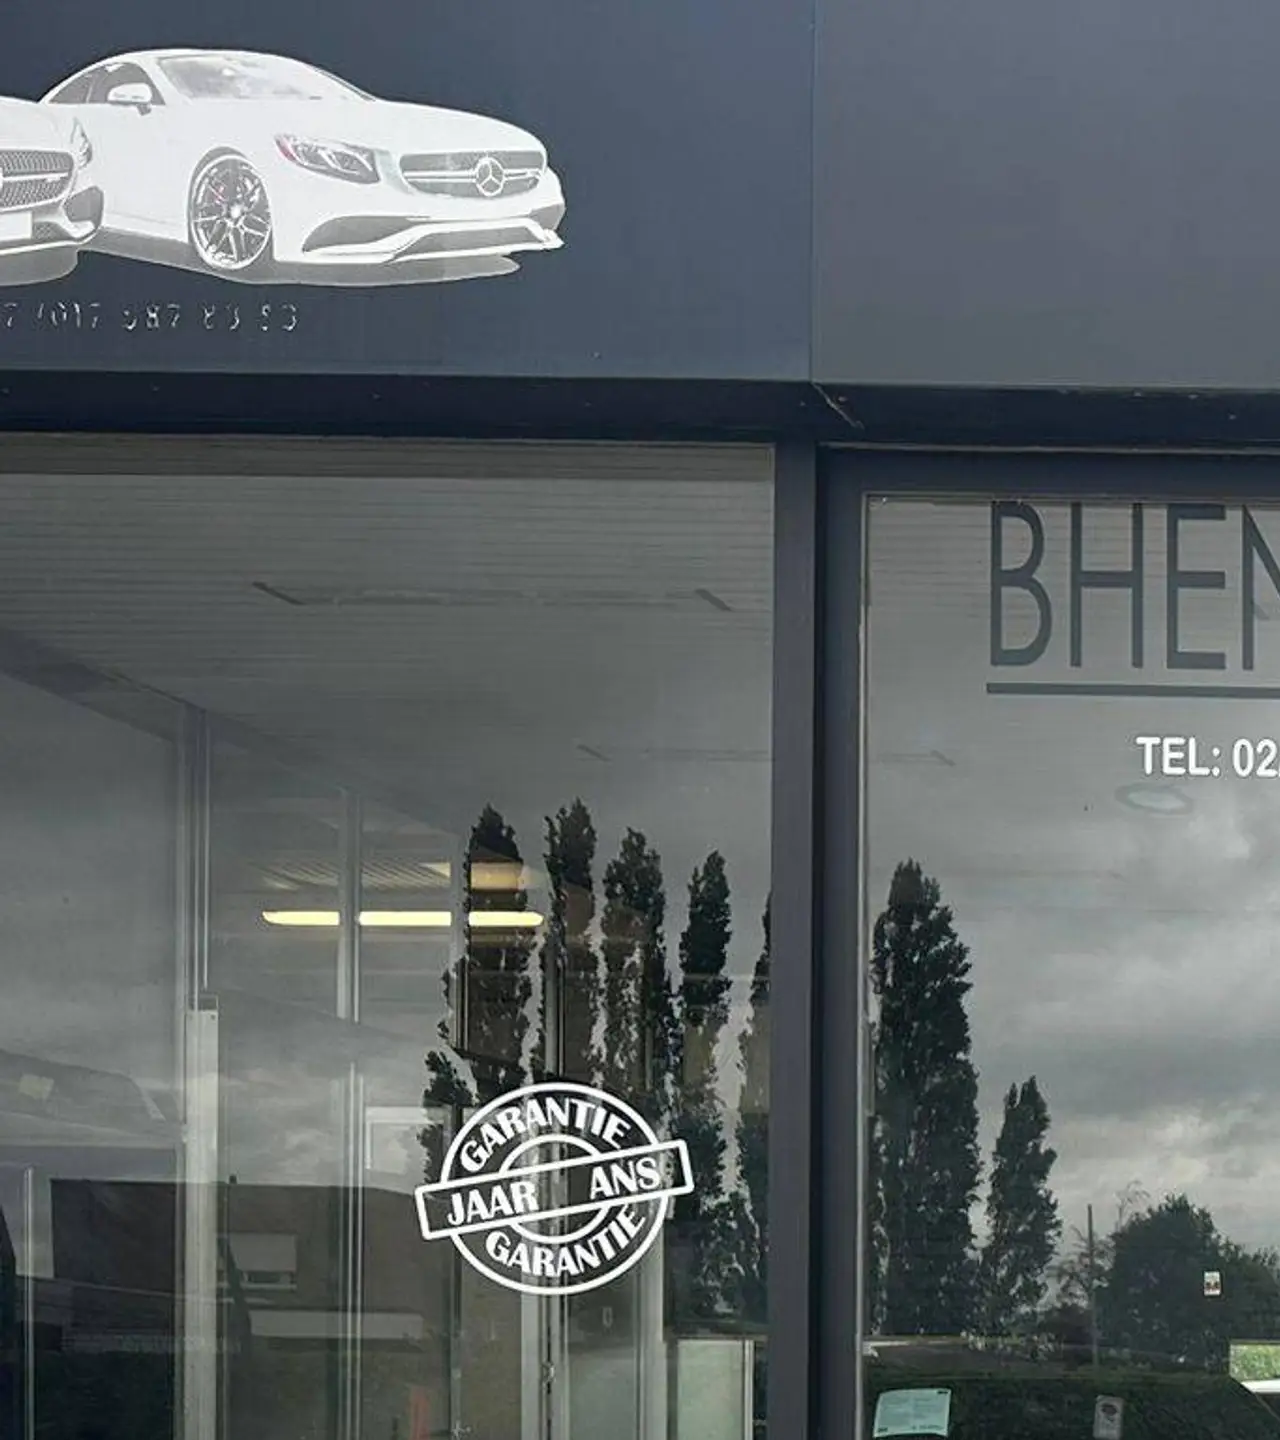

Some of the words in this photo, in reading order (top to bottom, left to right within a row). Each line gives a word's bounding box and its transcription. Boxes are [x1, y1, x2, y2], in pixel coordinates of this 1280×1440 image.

[1135, 736, 1221, 777] TEL:
[459, 1096, 632, 1172] GARANTIE
[447, 1180, 540, 1226] JAAR
[589, 1156, 661, 1200] ANS
[485, 1204, 646, 1278] GARANTIE
